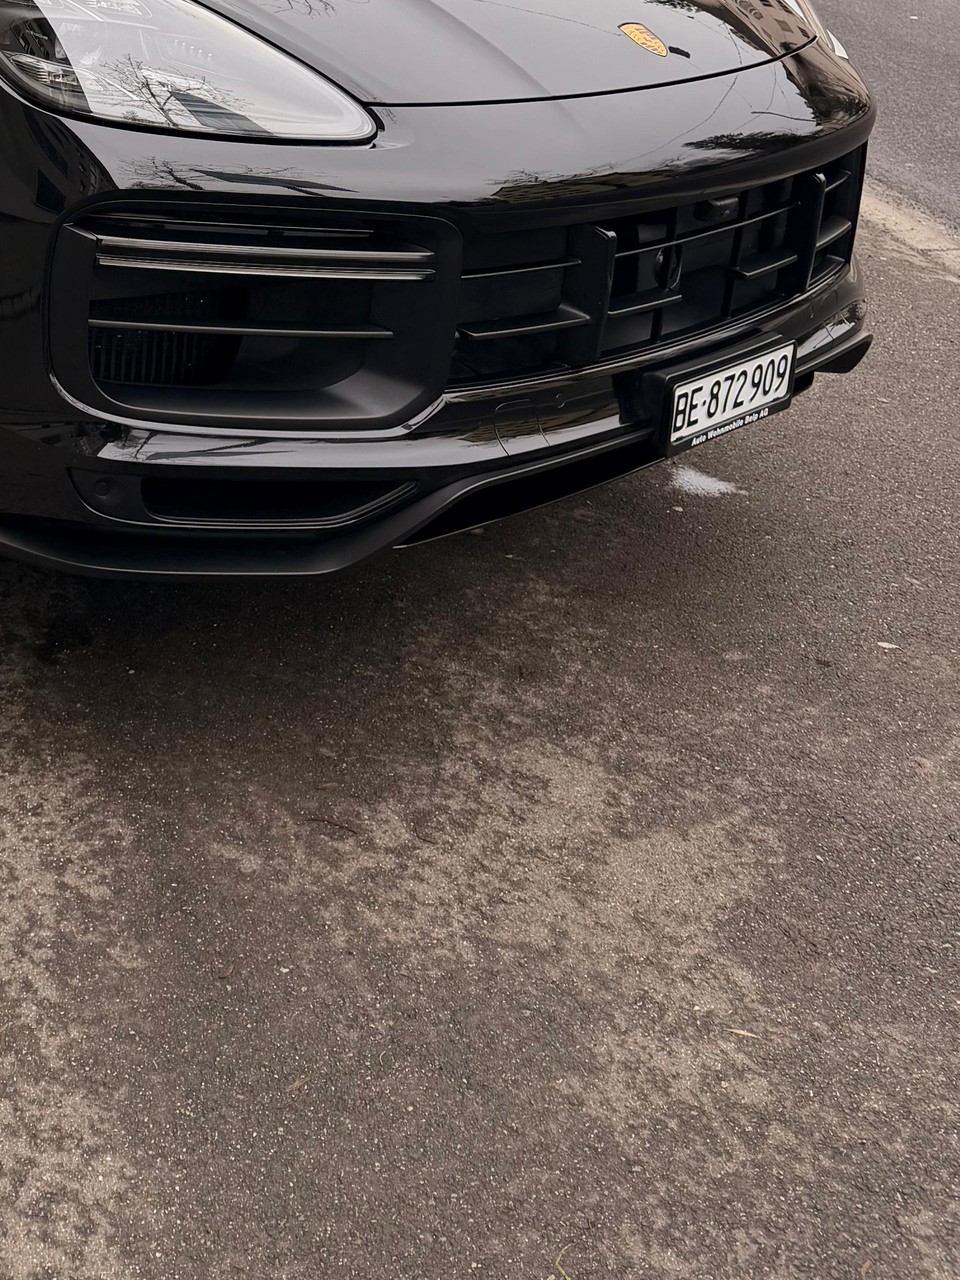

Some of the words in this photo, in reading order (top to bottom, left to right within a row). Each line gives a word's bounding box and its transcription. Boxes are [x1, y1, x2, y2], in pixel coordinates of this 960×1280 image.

[691, 434, 707, 447] Auto
[707, 418, 744, 440] Wohnmobile
[744, 412, 759, 424] Belp
[758, 407, 769, 418] AG
